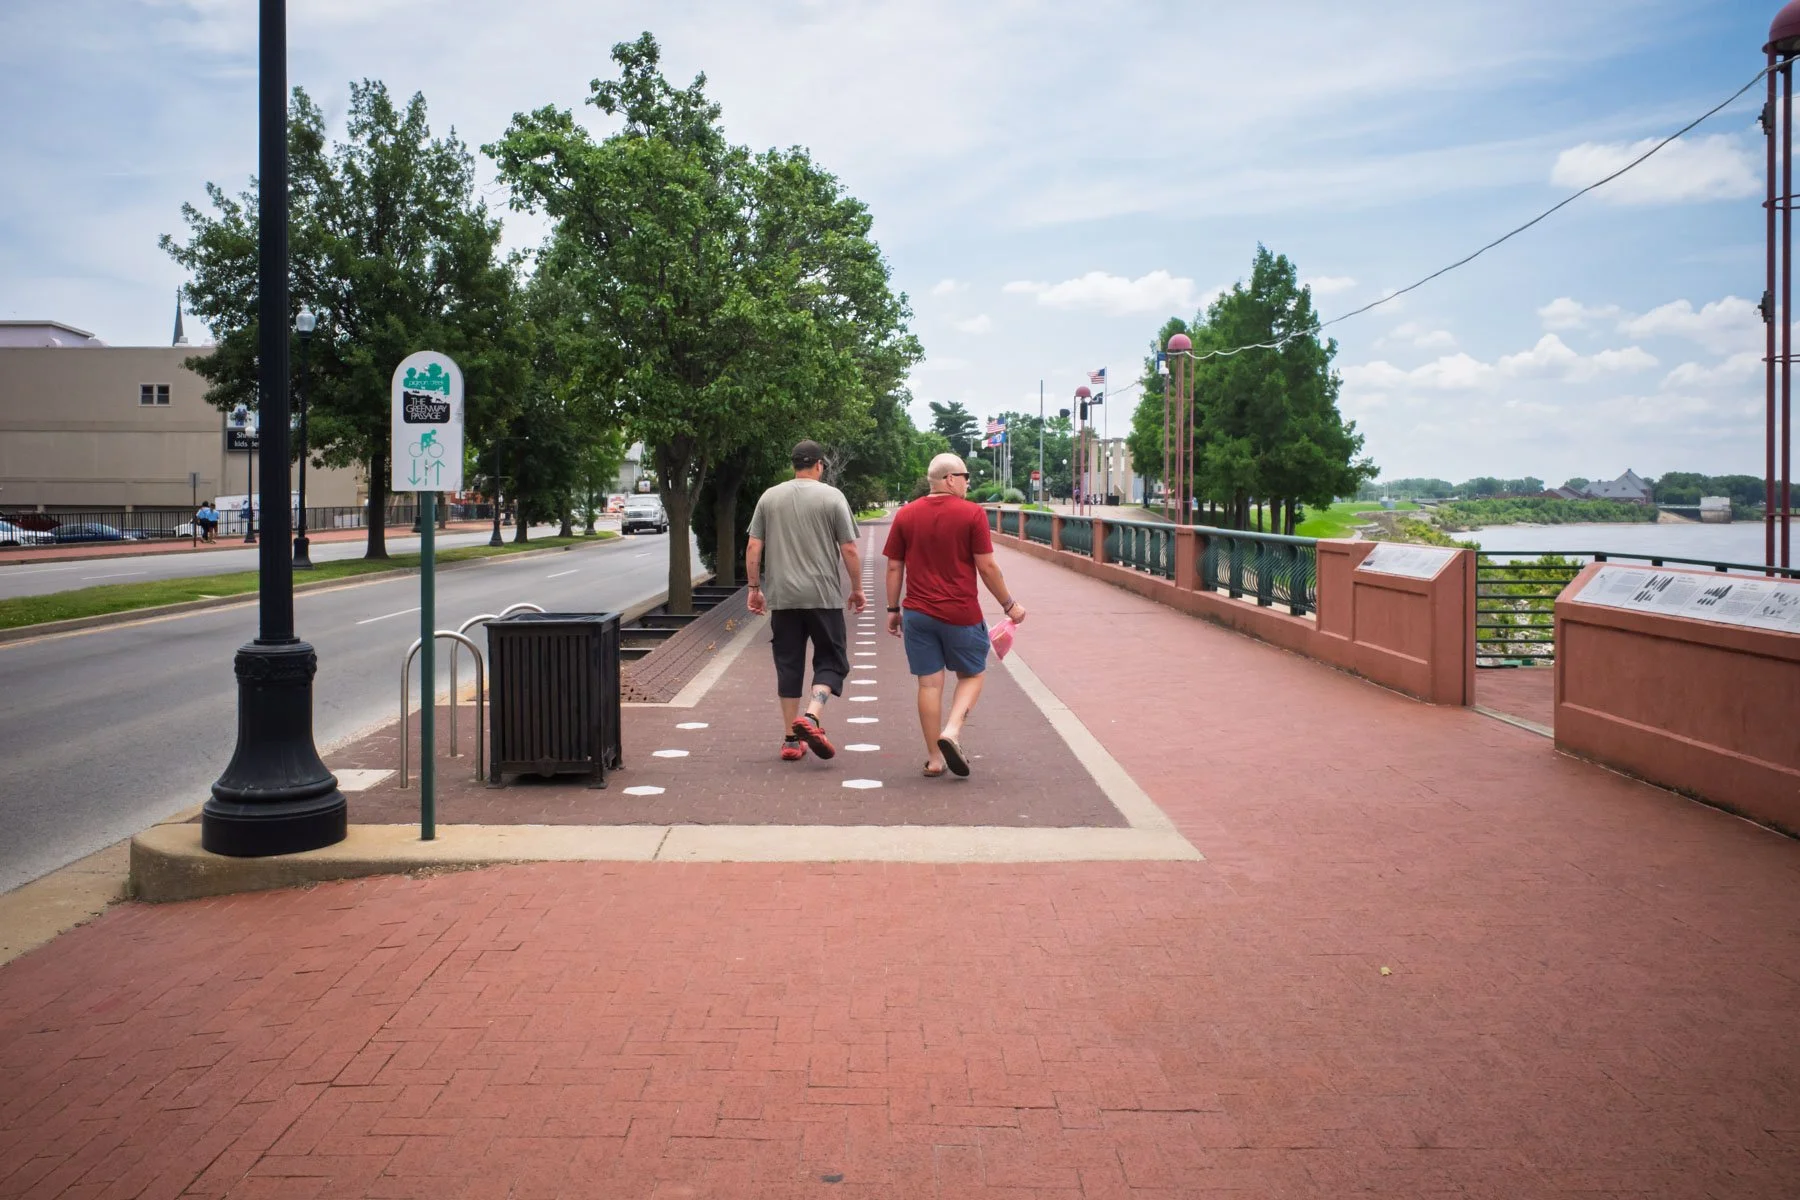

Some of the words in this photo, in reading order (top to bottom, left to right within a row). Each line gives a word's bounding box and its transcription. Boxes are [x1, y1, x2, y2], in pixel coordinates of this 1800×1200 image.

[410, 397, 426, 405] THE
[405, 404, 448, 413] GREENWAY
[410, 412, 441, 420] PASSAGE
